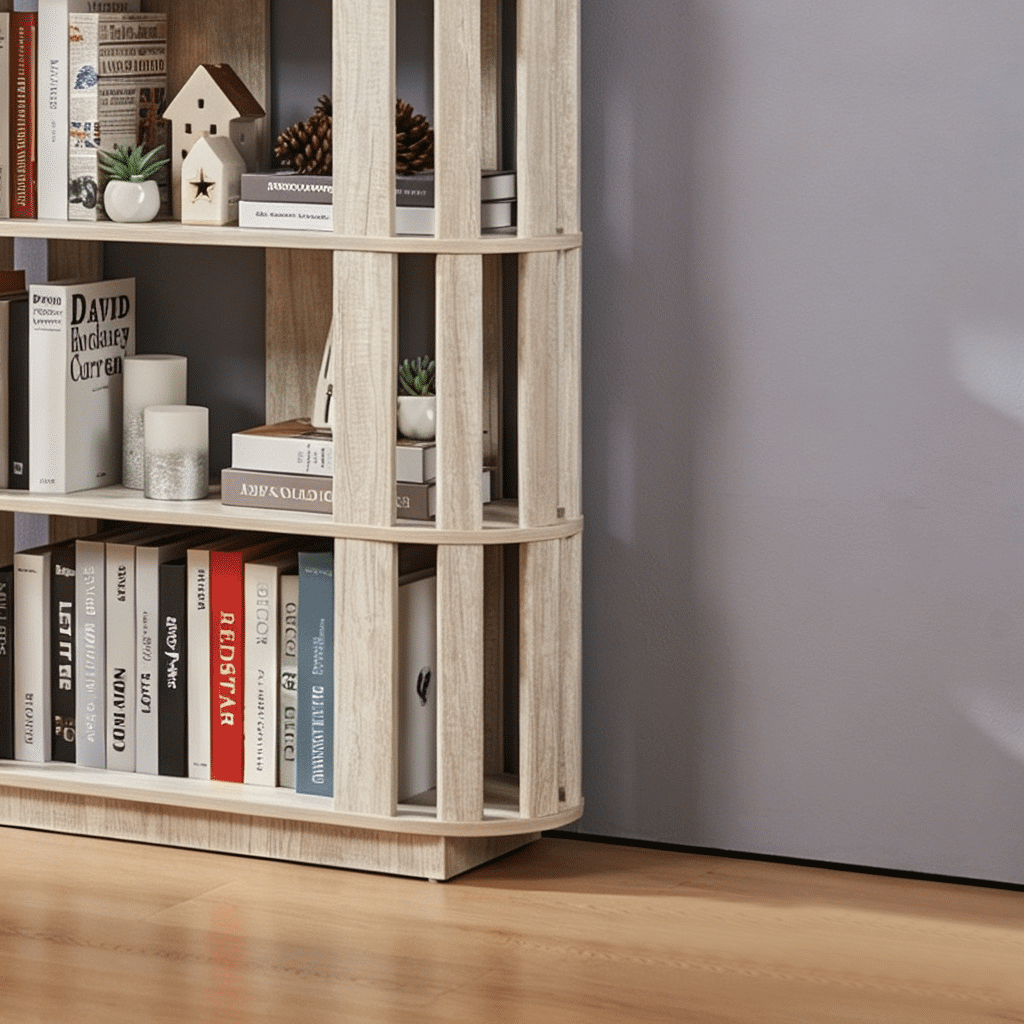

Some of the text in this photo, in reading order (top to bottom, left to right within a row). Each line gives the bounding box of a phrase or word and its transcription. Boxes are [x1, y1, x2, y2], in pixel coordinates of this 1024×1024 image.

[70, 293, 131, 325] DAVID
[58, 601, 72, 637] LET
[59, 641, 72, 662] IT
